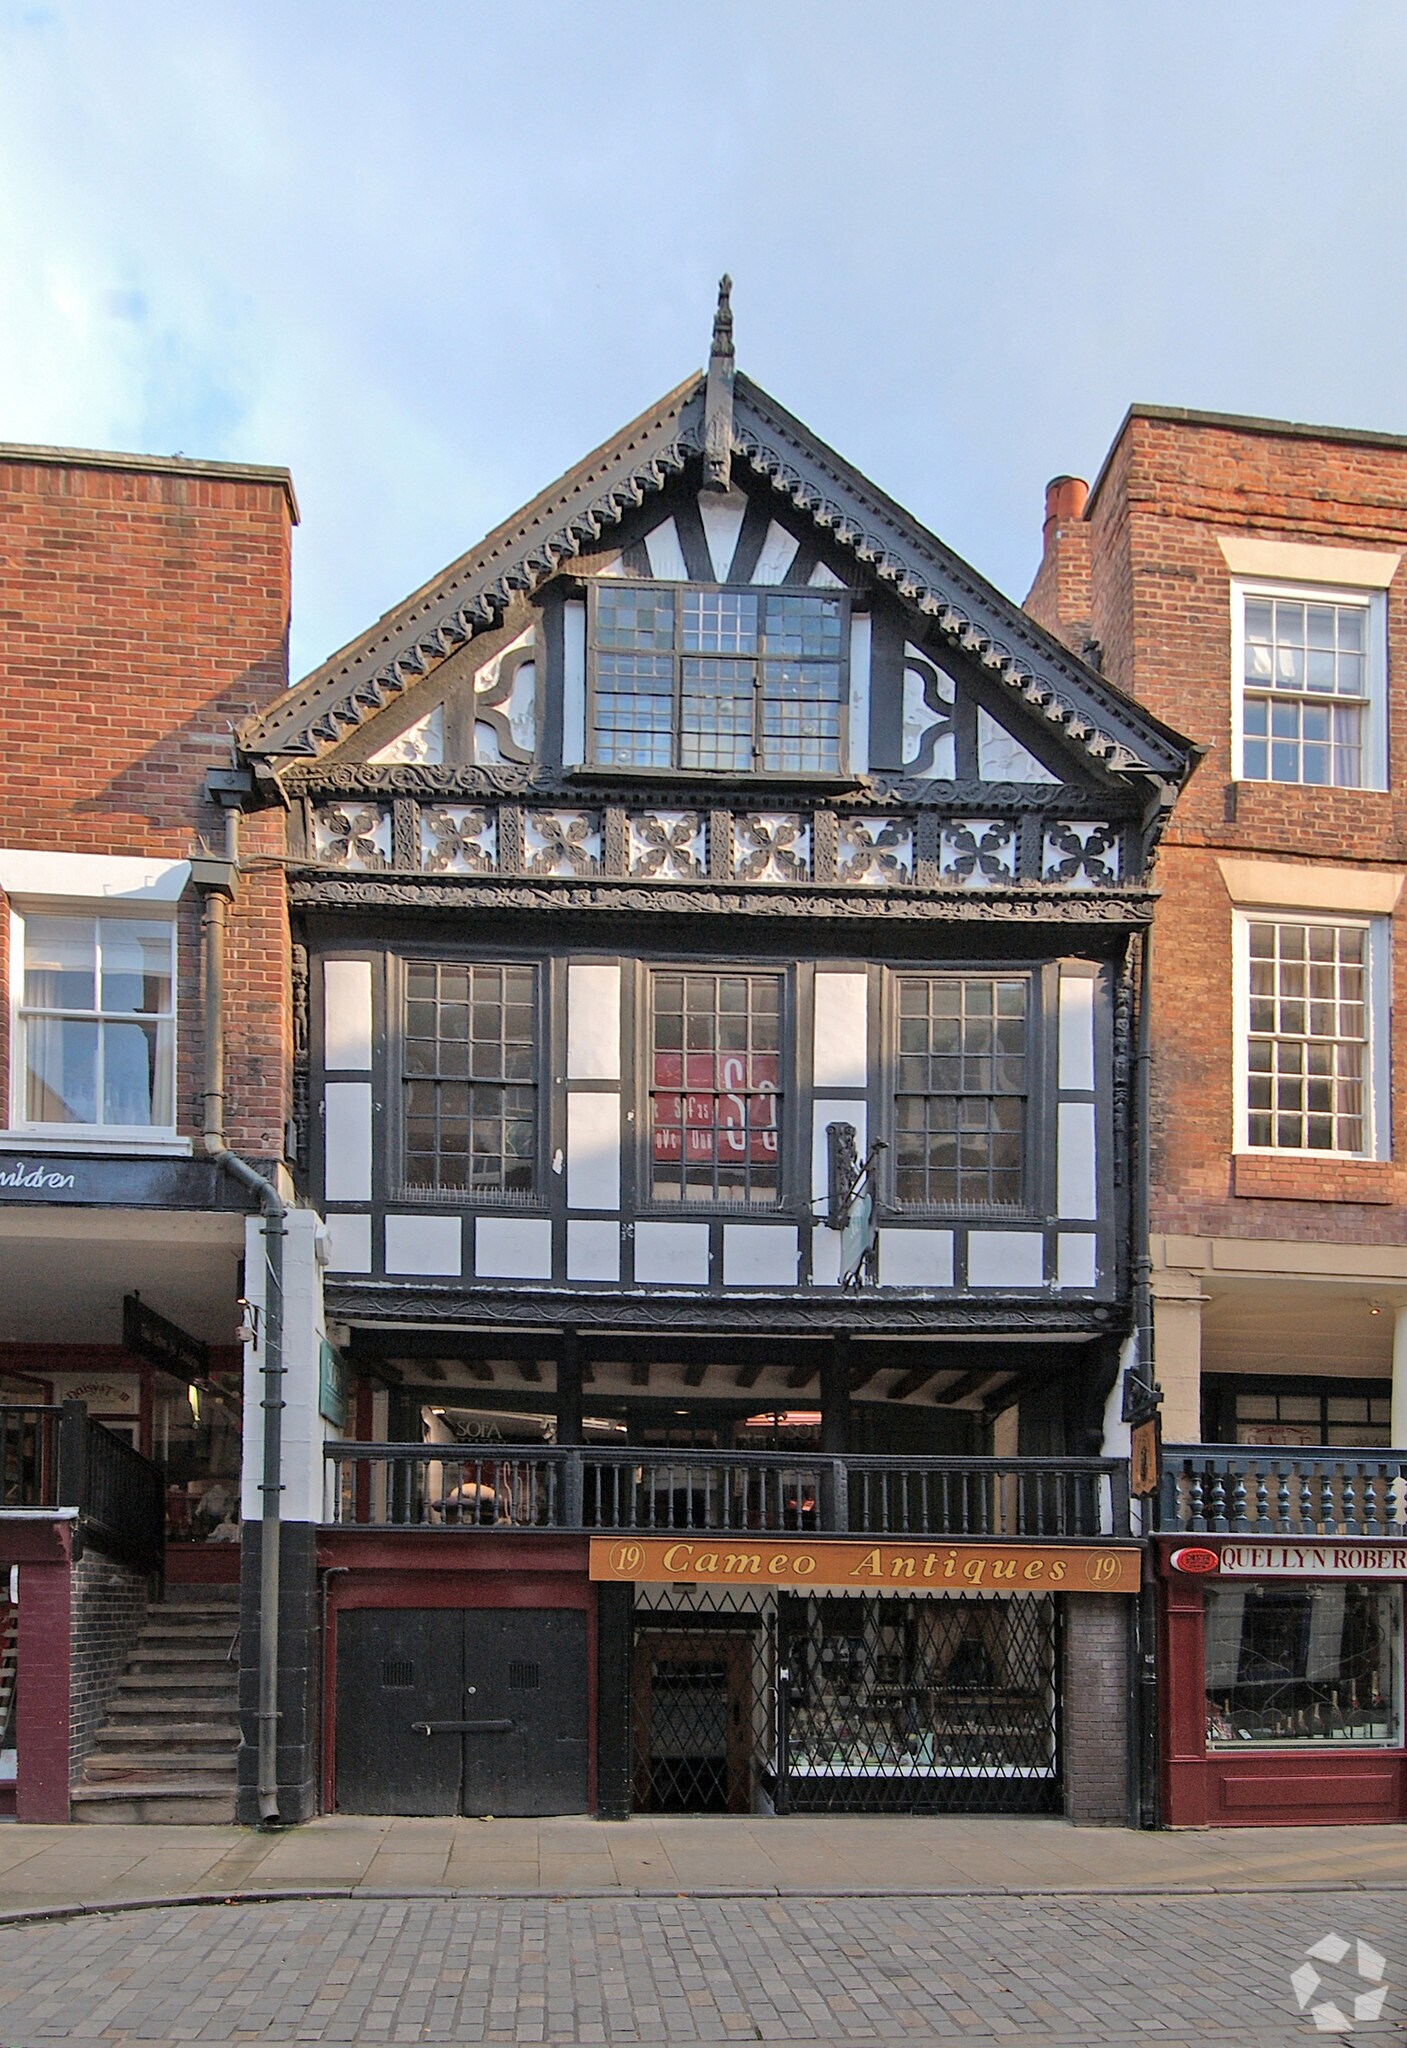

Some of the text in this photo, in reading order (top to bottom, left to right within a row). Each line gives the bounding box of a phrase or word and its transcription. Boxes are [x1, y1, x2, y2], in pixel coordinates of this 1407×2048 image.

[673, 1096, 709, 1119] Sfas
[456, 1420, 503, 1439] SOFA
[615, 1543, 1116, 1584] 19 Cameo Antiques 19
[1222, 1547, 1326, 1570] QUELLYN
[1333, 1548, 1407, 1569] ROBER
